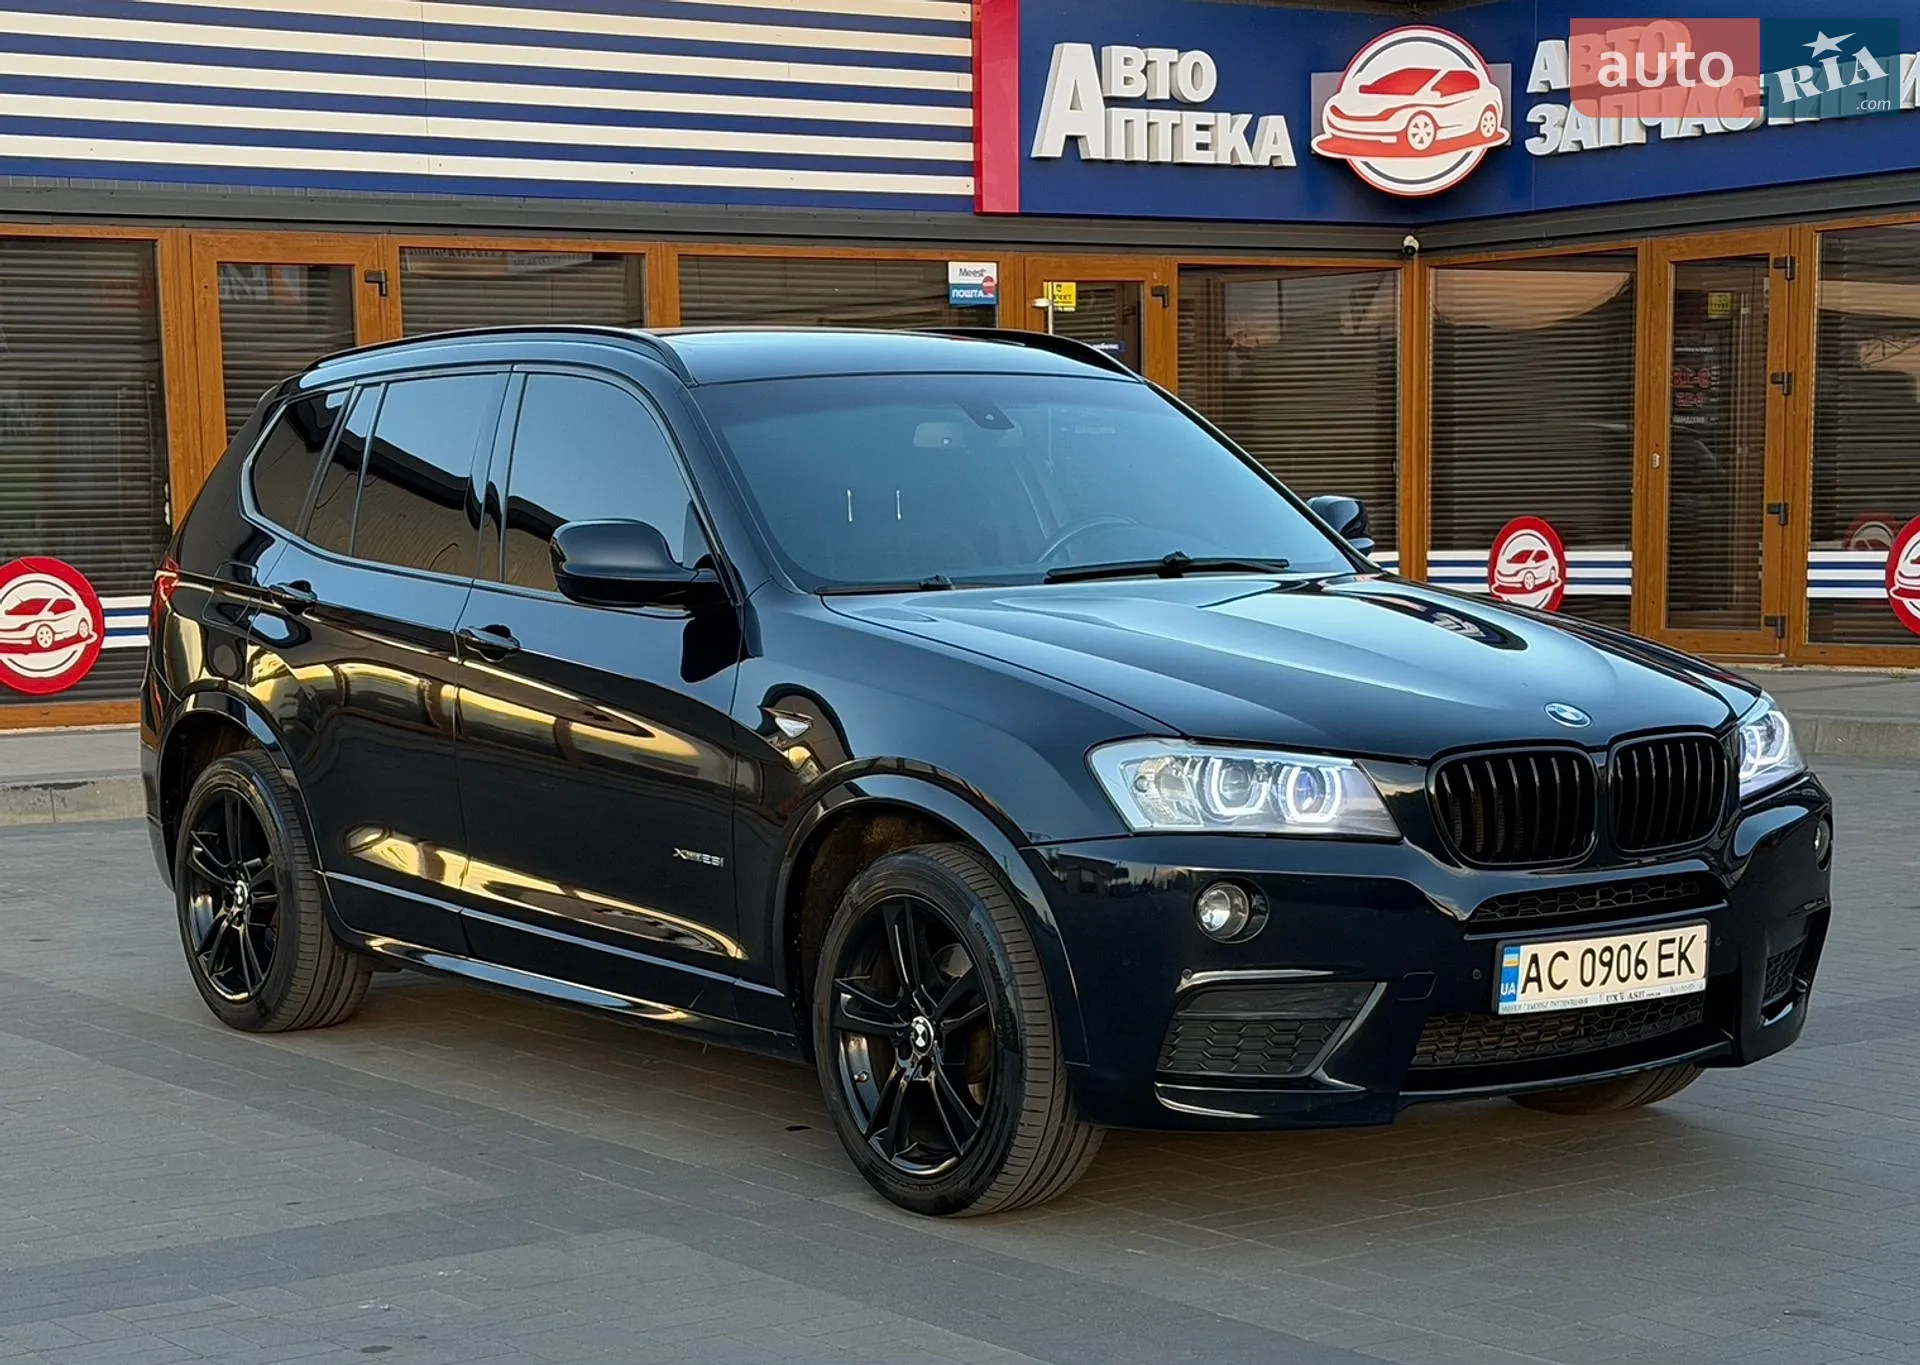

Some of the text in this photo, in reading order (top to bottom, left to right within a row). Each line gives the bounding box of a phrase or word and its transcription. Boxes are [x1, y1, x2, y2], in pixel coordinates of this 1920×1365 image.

[1521, 933, 1698, 994] AC 0906 EK
[1501, 983, 1516, 995] UA
